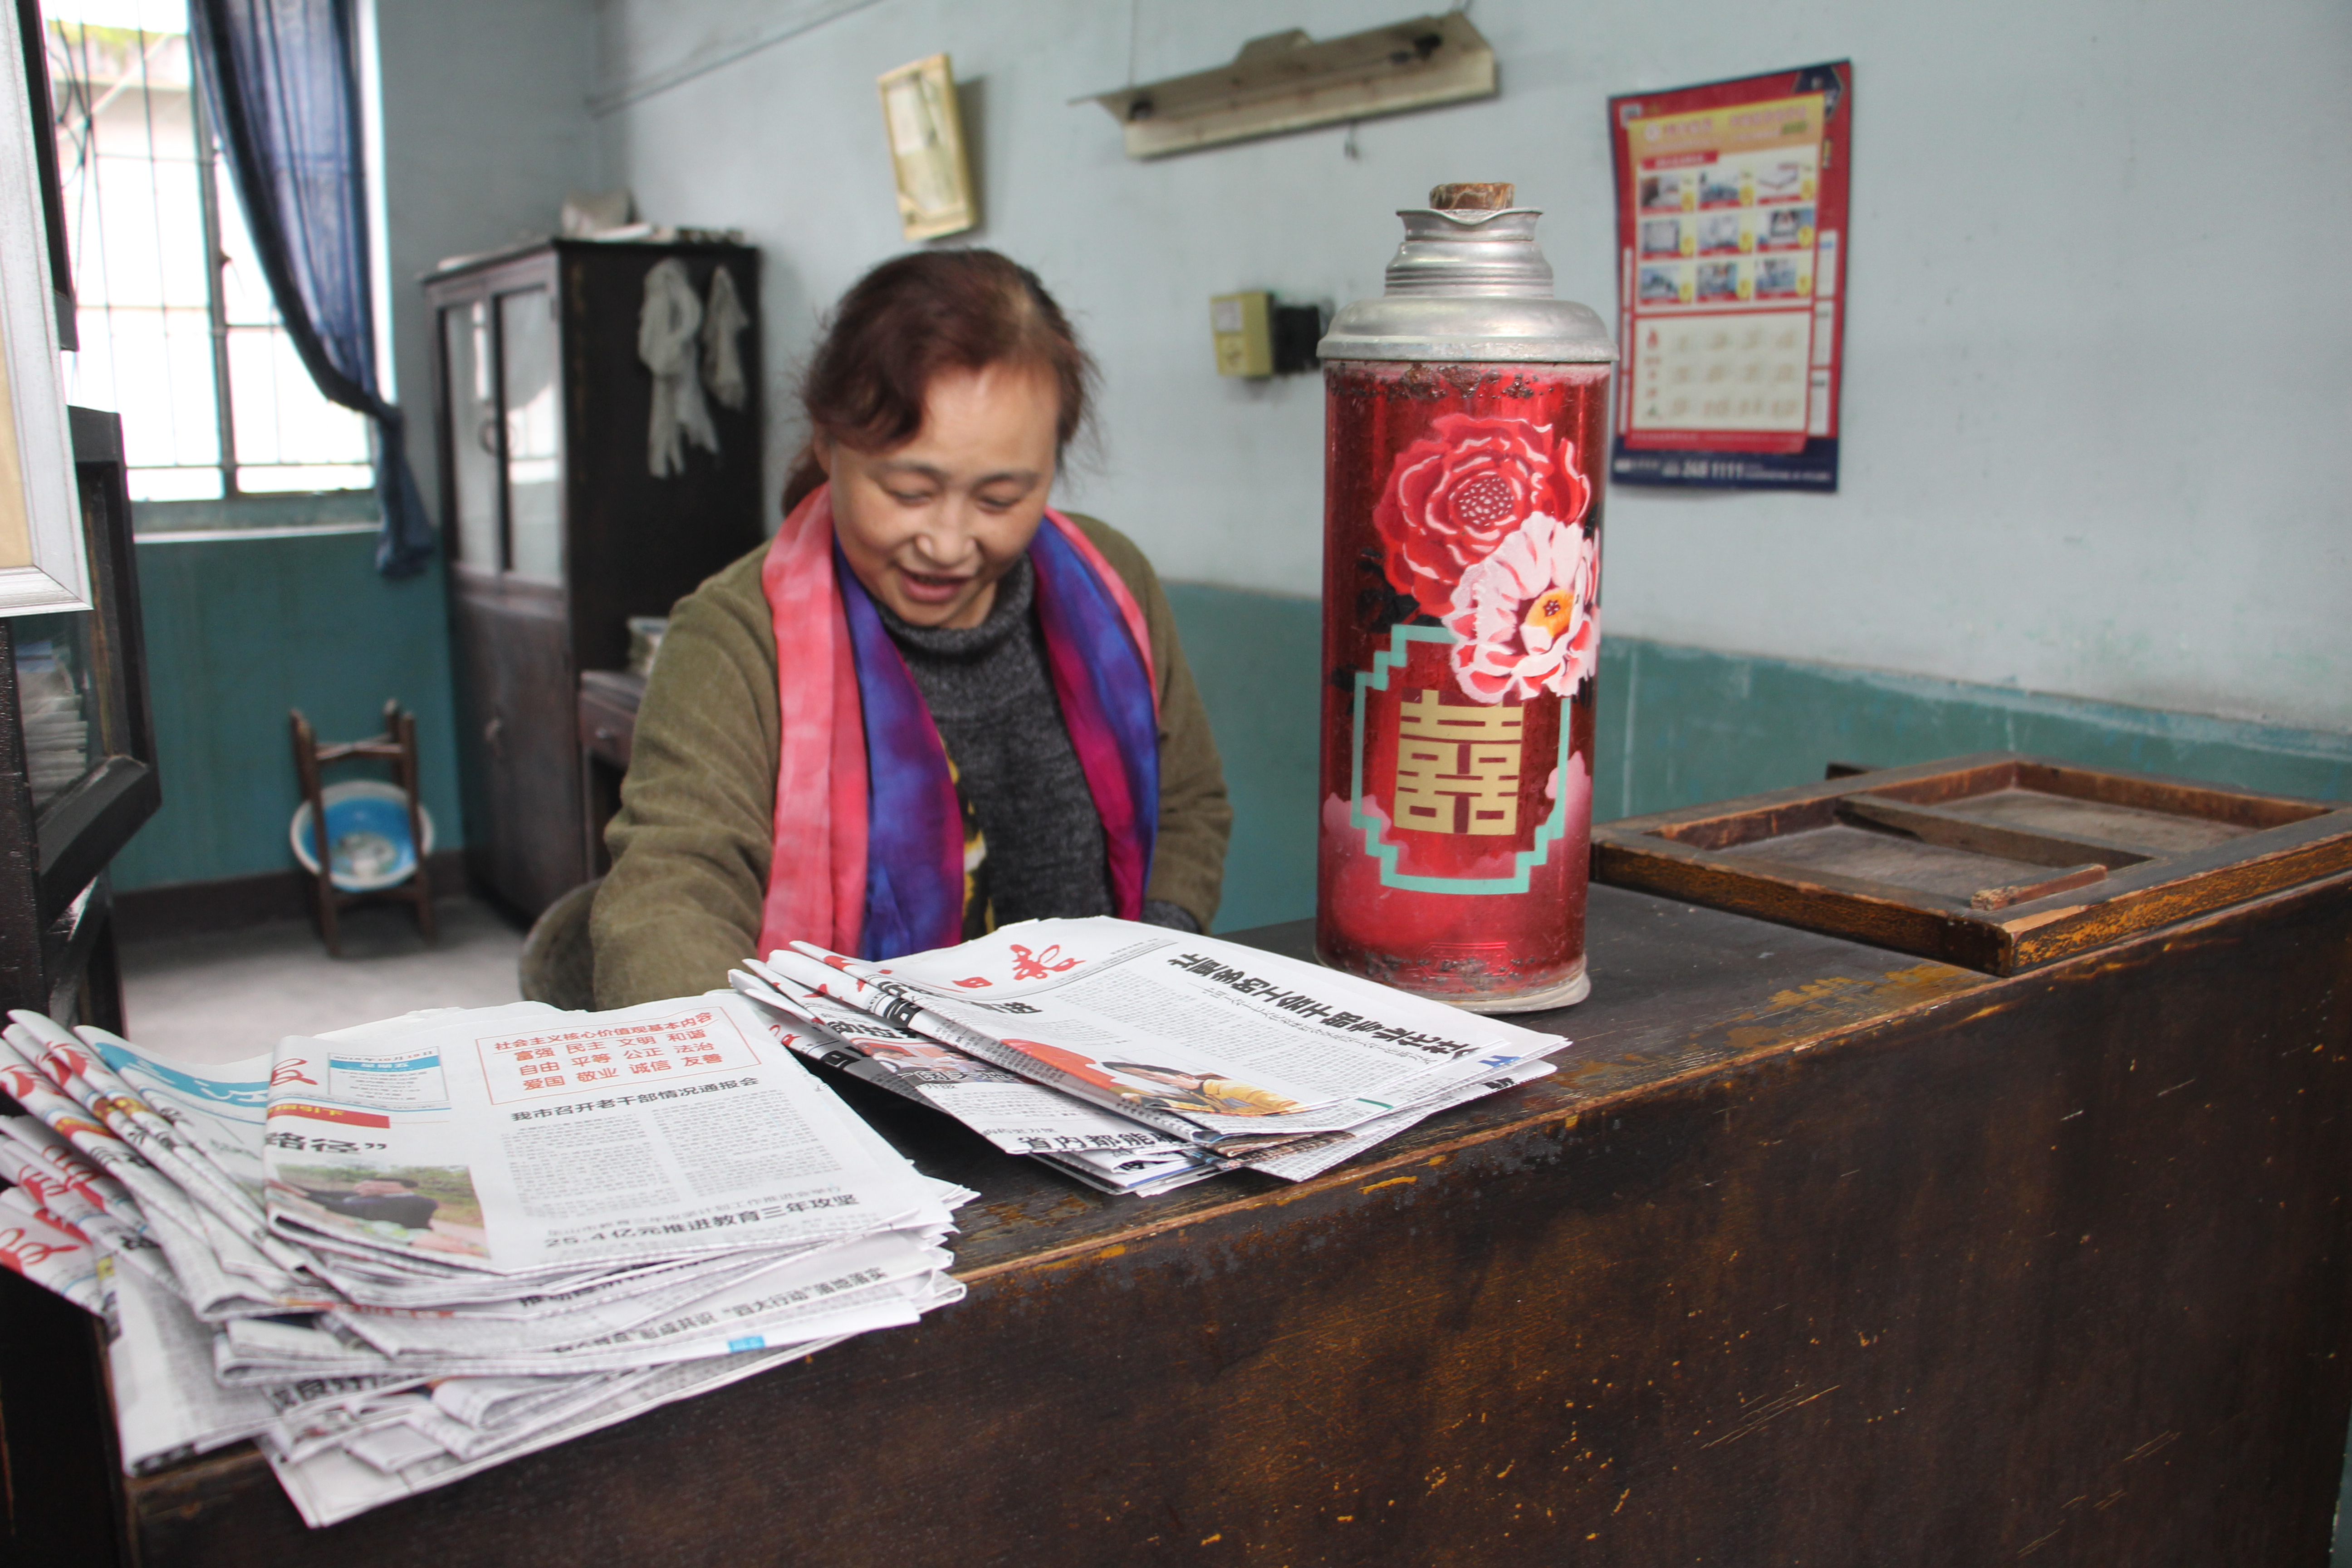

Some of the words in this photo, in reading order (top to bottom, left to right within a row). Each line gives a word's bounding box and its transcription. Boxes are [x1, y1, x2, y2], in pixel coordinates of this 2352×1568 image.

[495, 1011, 713, 1051] 社会主义核心价值观基本内容
[514, 1047, 556, 1062] 富强
[566, 1039, 606, 1055] 民主
[618, 1034, 657, 1048] 文明
[668, 1029, 706, 1043] 和谐
[519, 1061, 560, 1076] 自由
[571, 1053, 612, 1068] 平等
[623, 1046, 664, 1060] 公正
[673, 1042, 715, 1054] 法治
[523, 1075, 565, 1091] 爱国
[576, 1067, 619, 1083] 敬业
[629, 1060, 671, 1075] 诚信
[683, 1053, 723, 1068] 友善
[511, 1076, 759, 1122] 我市召开老干部情况通报会
